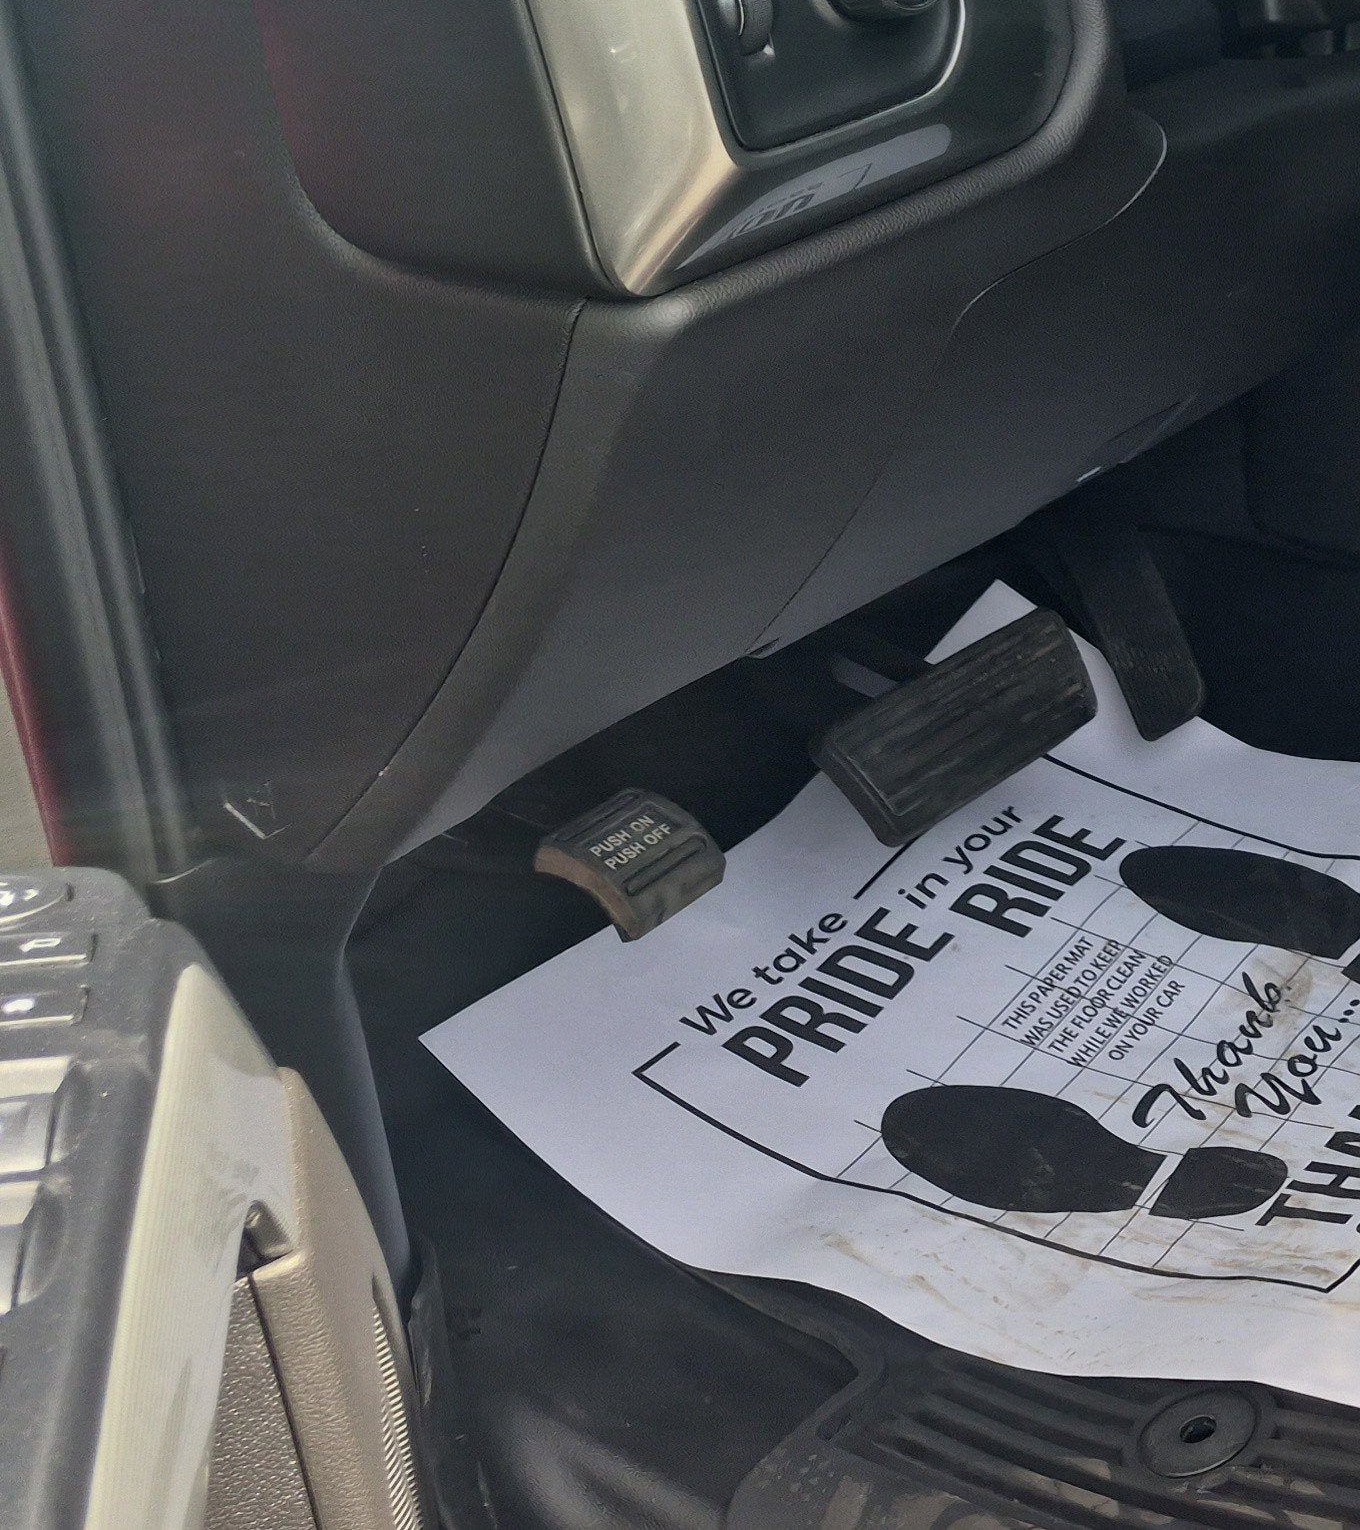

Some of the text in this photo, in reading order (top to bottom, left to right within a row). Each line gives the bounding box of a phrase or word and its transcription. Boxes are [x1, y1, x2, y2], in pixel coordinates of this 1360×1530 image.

[590, 815, 655, 857] PUSH ON
[604, 823, 671, 870] PUSH OFF
[679, 805, 1023, 1036] We take in your
[720, 814, 1128, 1088] PRIDE RIDE
[1002, 936, 1094, 1030] THIS PAPER MAT
[1019, 938, 1123, 1047] WAS USED TO KEEP
[1048, 948, 1148, 1053] THE FLOOR CLEAN
[1066, 954, 1174, 1068] WHILE WE WORKED
[1108, 979, 1186, 1061] ON YOUR CAR
[1131, 971, 1282, 1128] Thank
